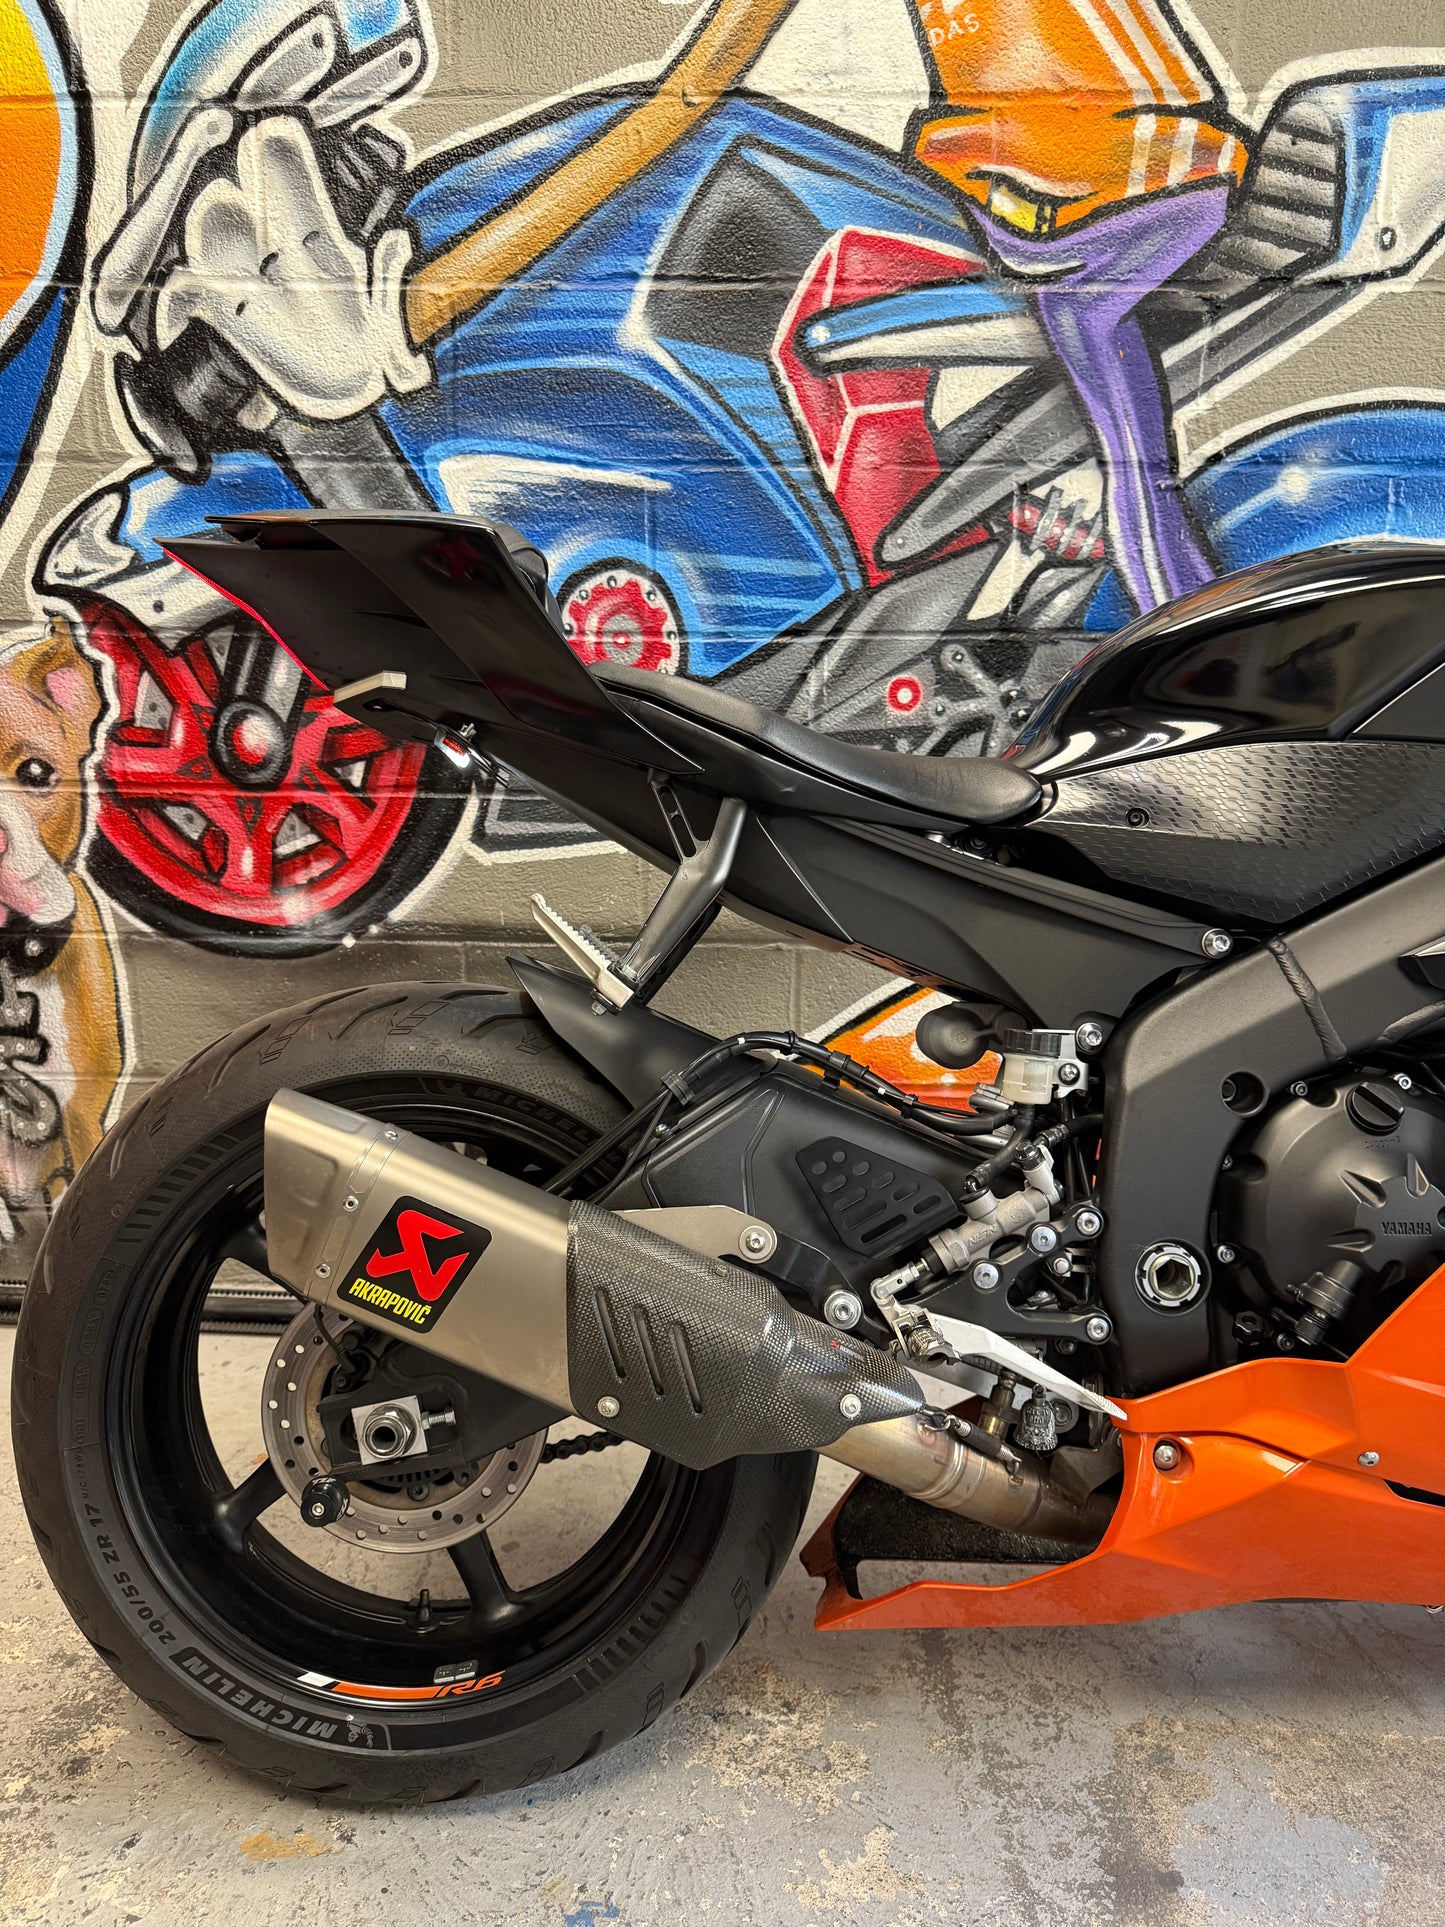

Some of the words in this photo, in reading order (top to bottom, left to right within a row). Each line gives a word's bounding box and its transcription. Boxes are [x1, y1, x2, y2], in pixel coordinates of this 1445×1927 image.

[930, 13, 980, 46] DAS
[474, 1086, 624, 1167] MICHELN
[1381, 1221, 1433, 1236] YAMAHA
[348, 1277, 432, 1325] AKRAPOVIČ
[112, 1571, 177, 1645] 200/55
[182, 1655, 339, 1740] MICHELIN
[436, 1669, 506, 1698] R6
